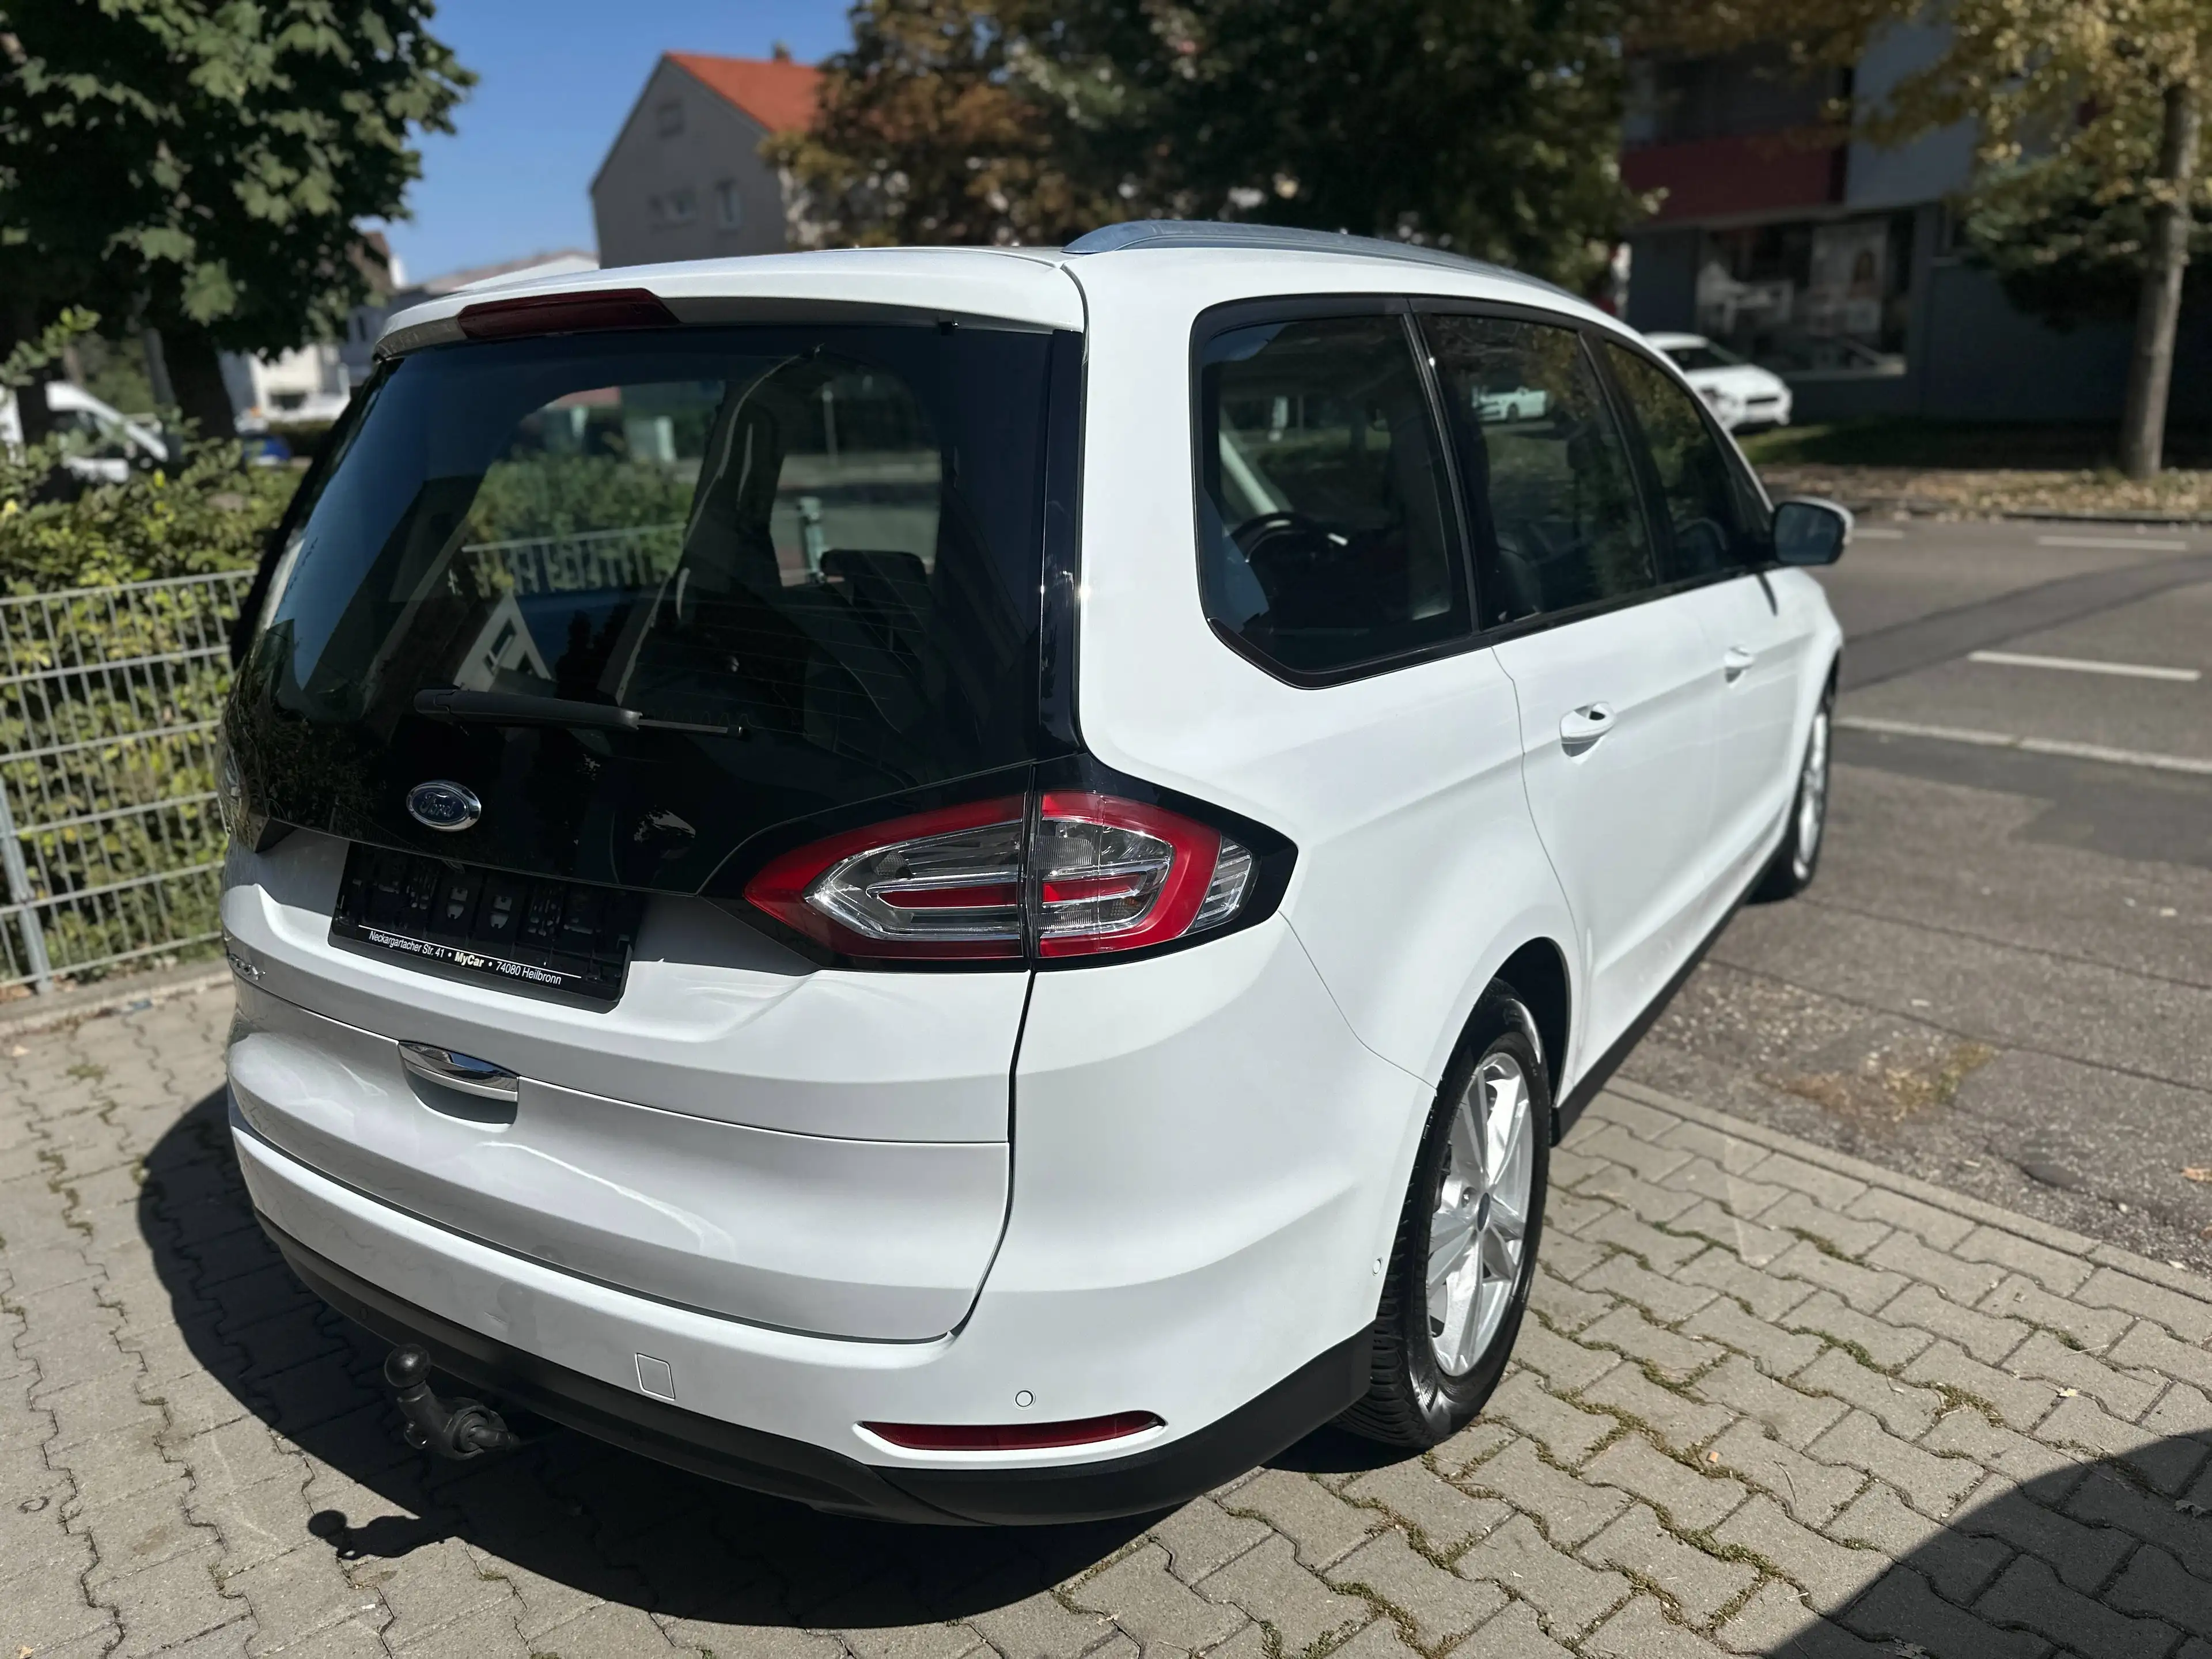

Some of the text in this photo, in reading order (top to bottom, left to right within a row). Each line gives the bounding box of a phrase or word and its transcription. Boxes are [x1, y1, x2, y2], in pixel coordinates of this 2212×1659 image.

[419, 791, 456, 818] Ford
[369, 930, 562, 985] Neckargartacher Str. 41 MyCar 74080 Heilbronn
